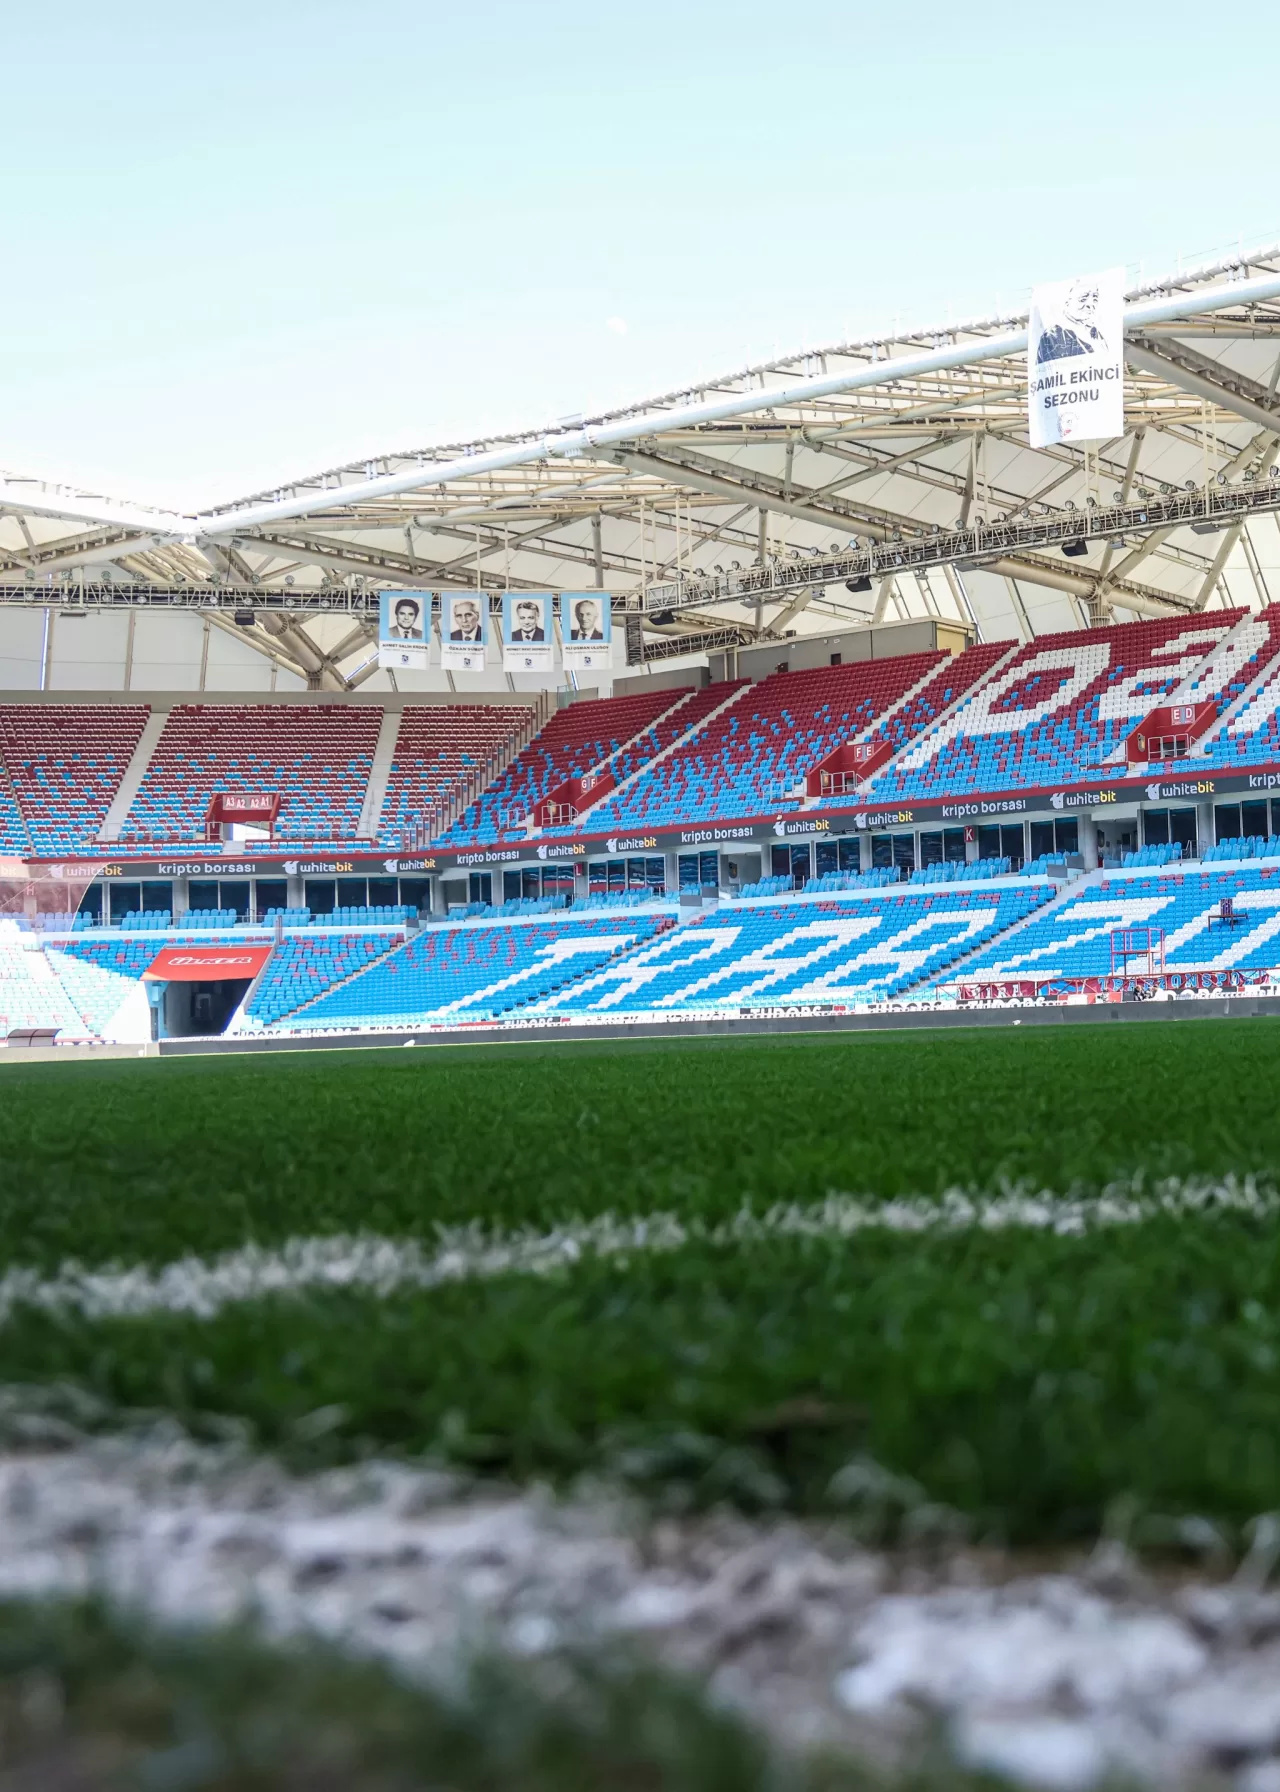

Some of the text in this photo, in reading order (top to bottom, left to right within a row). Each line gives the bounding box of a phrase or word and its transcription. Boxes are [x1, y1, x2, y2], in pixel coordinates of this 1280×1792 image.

[1030, 363, 1120, 396] ŞAMİL EKİNCİ
[1044, 388, 1100, 409] SEZONU
[1173, 707, 1194, 719] E D
[856, 746, 872, 758] F E
[581, 778, 596, 789] G F
[1162, 781, 1215, 797] whitebit
[226, 797, 246, 809] A3 A2
[250, 797, 269, 808] A2 A1
[1066, 791, 1116, 806] whitebit
[942, 799, 1026, 818] kripto borsası
[868, 811, 913, 826] whitebit
[787, 819, 830, 833] whitebit
[681, 827, 753, 844] kripto borsası
[966, 828, 973, 841] K
[548, 844, 585, 856] whitebit
[618, 837, 657, 850] whitebit
[400, 858, 436, 870] whitebit
[457, 851, 520, 866] kripto borsası
[67, 865, 122, 877] whitebit
[158, 862, 256, 876] kripto borsası
[300, 862, 353, 873] whitebit
